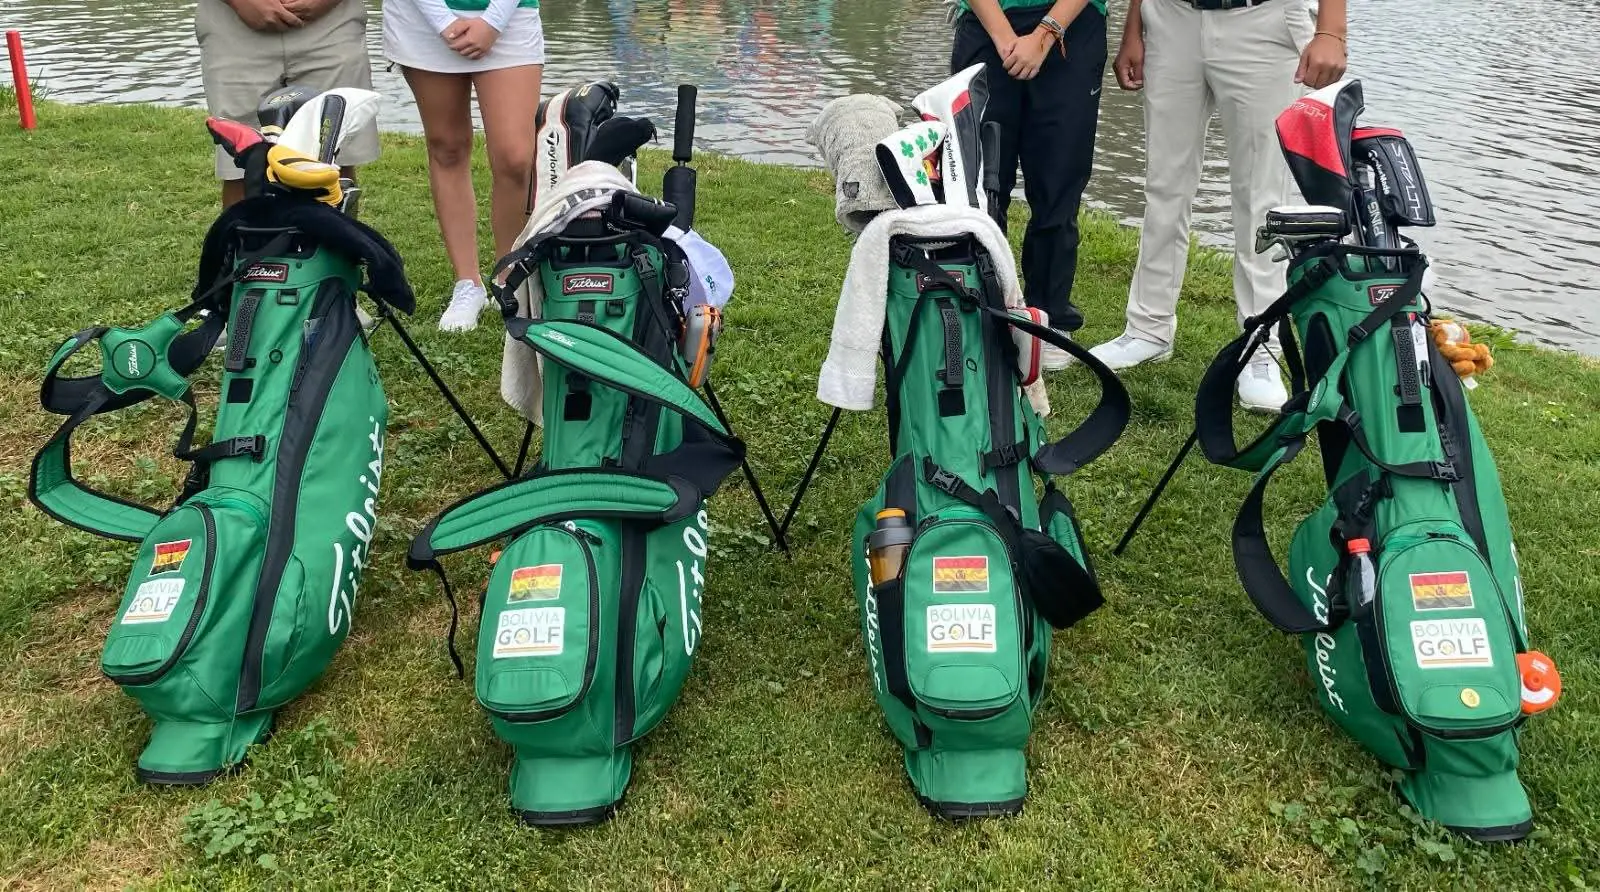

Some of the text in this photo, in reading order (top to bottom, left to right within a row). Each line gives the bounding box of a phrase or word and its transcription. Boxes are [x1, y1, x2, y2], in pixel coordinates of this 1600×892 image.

[1368, 149, 1391, 195] TaylorMade
[1367, 201, 1385, 237] PING
[567, 277, 609, 291] Titleist
[128, 596, 178, 614] GOLF
[501, 611, 560, 627] BOLIVIA
[931, 607, 992, 623] BOLIVIA
[498, 626, 561, 646] GOLF
[930, 623, 993, 641] GOLF
[1414, 622, 1482, 638] BOLIVIA
[1418, 637, 1486, 657] GOLF
